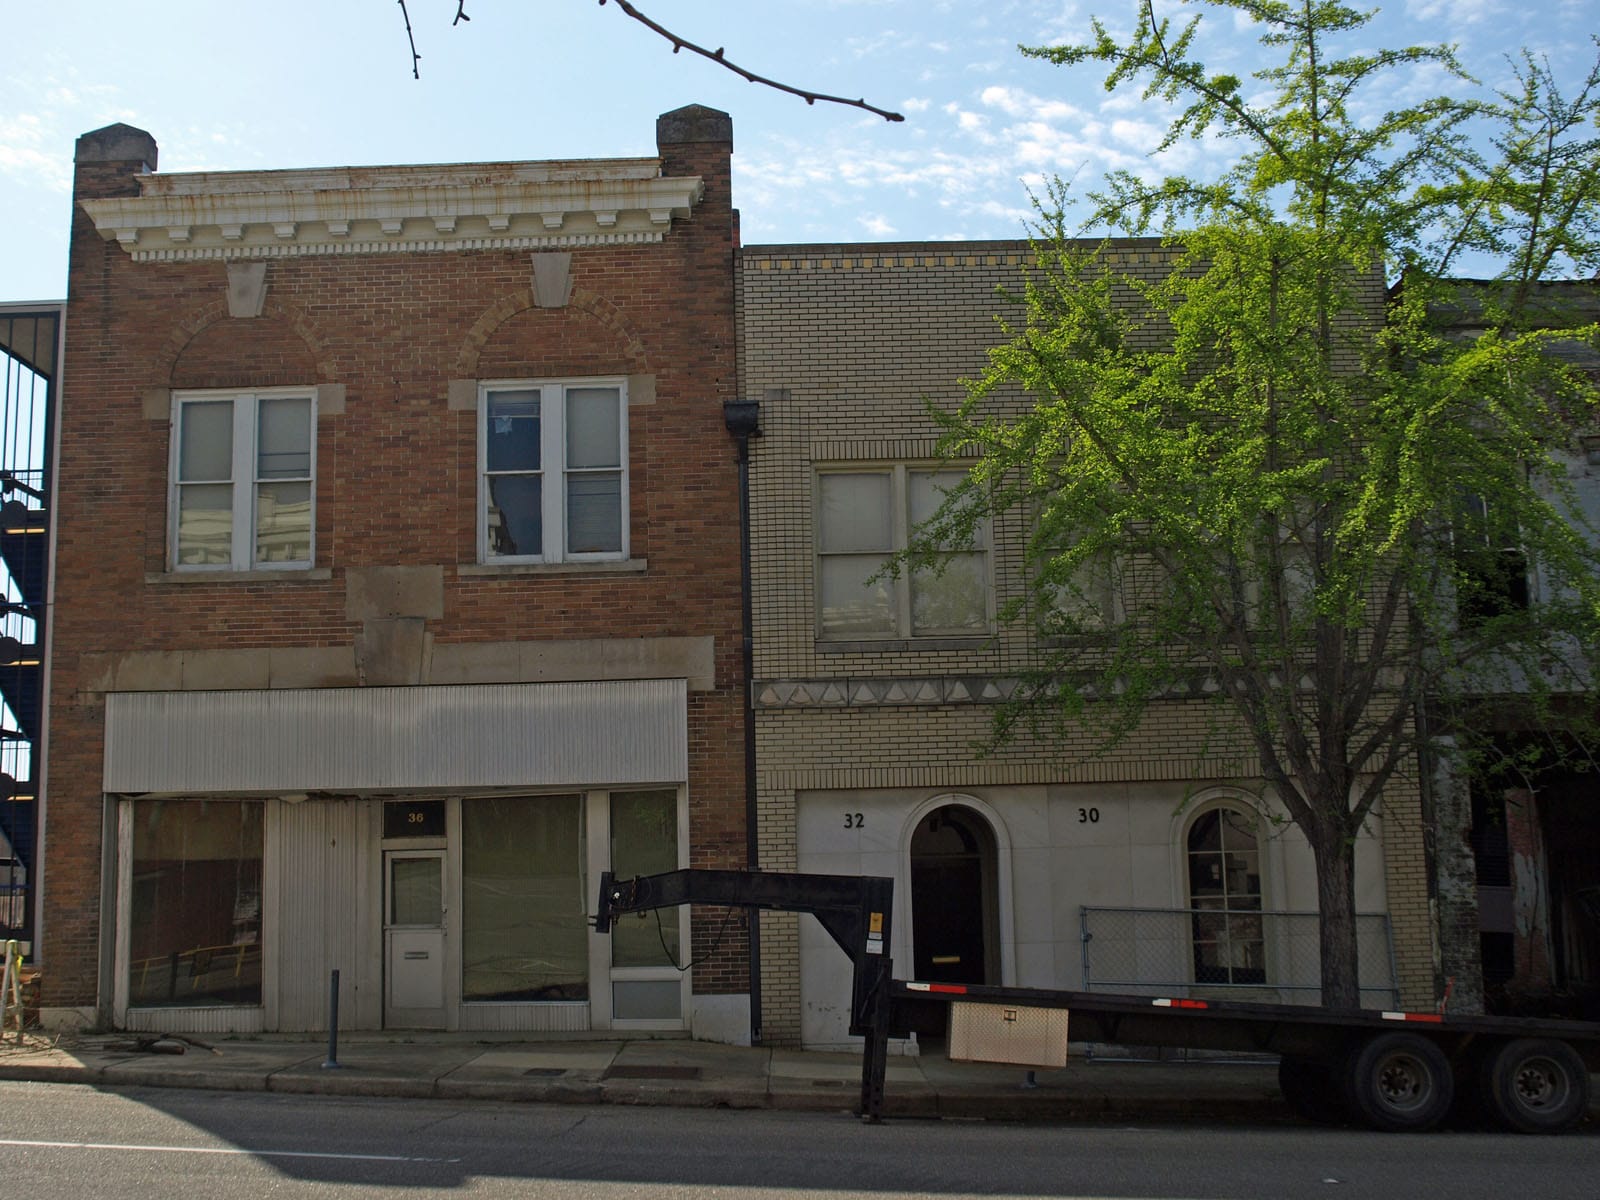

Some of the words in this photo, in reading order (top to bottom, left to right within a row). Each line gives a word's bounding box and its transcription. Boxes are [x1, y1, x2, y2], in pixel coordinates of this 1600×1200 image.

[408, 813, 424, 823] 36
[843, 812, 865, 829] 32
[1078, 807, 1100, 824] 30
